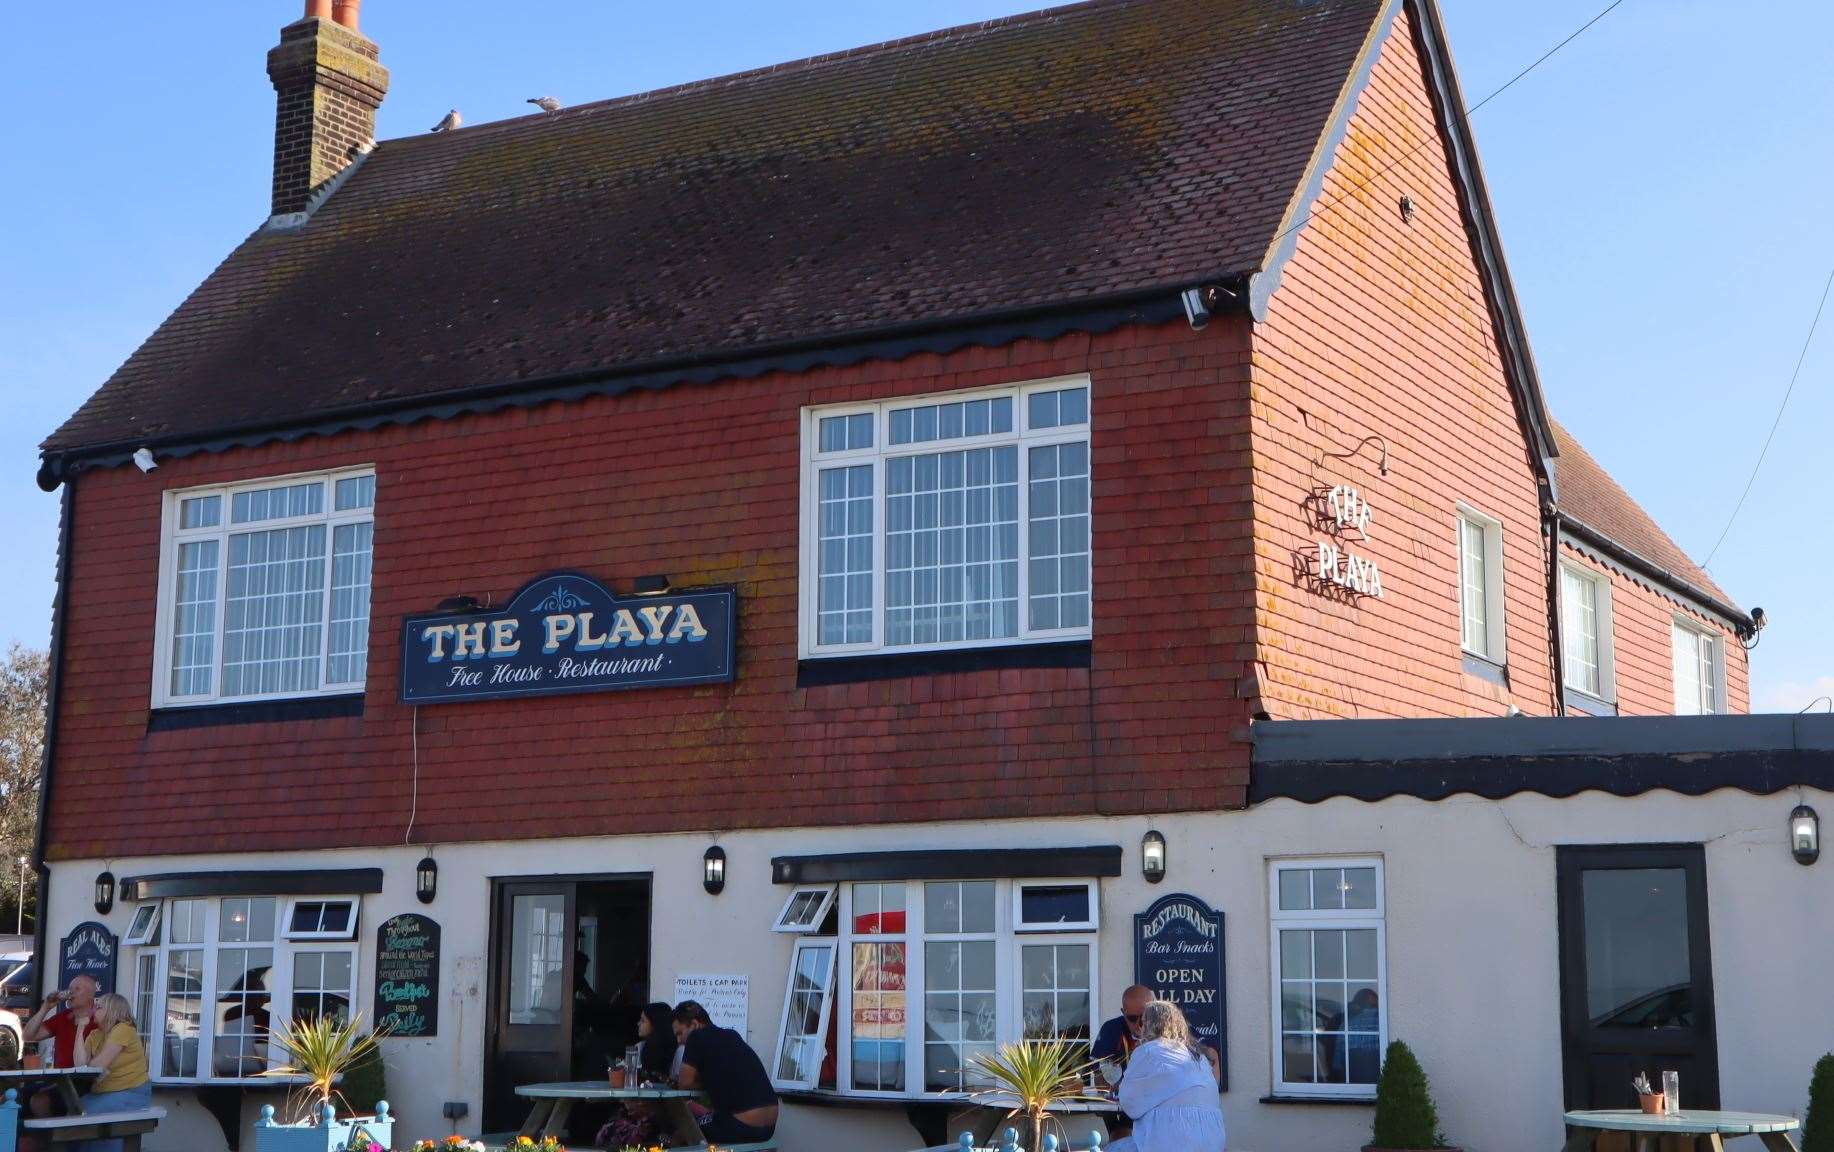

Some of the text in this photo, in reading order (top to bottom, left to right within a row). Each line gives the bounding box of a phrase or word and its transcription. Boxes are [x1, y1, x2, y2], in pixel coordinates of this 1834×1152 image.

[1318, 542, 1385, 599] PLAYA
[421, 603, 709, 663] THE PLAYA
[446, 652, 665, 688] Free House Restaurant
[1143, 903, 1218, 940] RESTAURANT
[67, 930, 111, 957] REAL ALES
[1145, 940, 1215, 954] Bar Snacks
[1155, 968, 1205, 984] OPEN
[1184, 989, 1217, 1004] DAY
